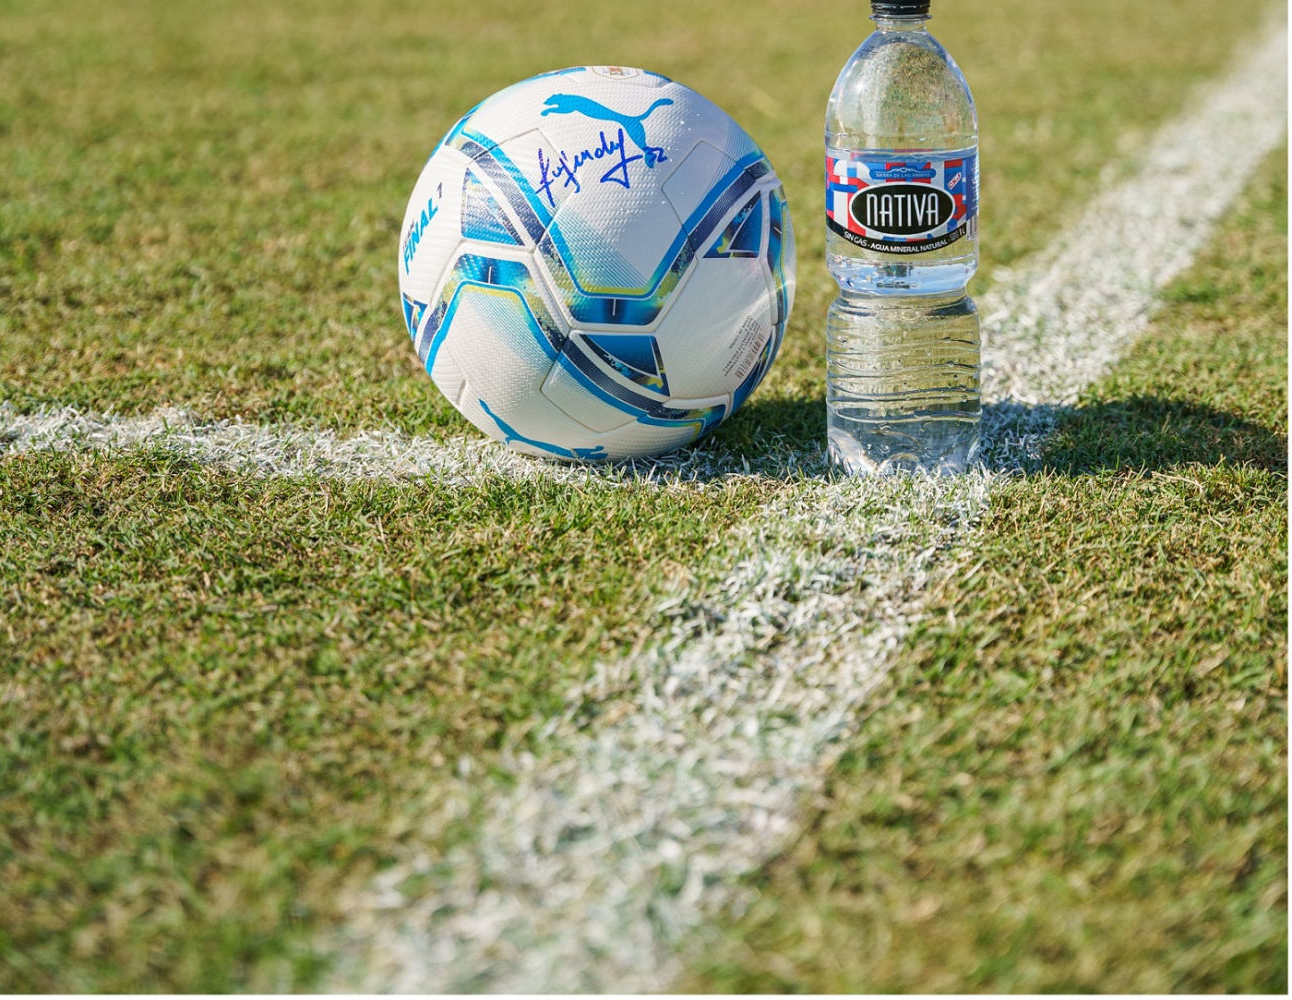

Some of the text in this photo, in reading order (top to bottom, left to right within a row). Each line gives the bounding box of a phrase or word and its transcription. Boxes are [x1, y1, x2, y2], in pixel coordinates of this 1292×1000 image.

[866, 193, 939, 227] NATIVA
[404, 197, 439, 276] FINAL
[843, 230, 854, 241] SIN
[870, 242, 889, 251] AGUA
[889, 245, 919, 253] MINERAL
[920, 239, 948, 251] NATURAL
